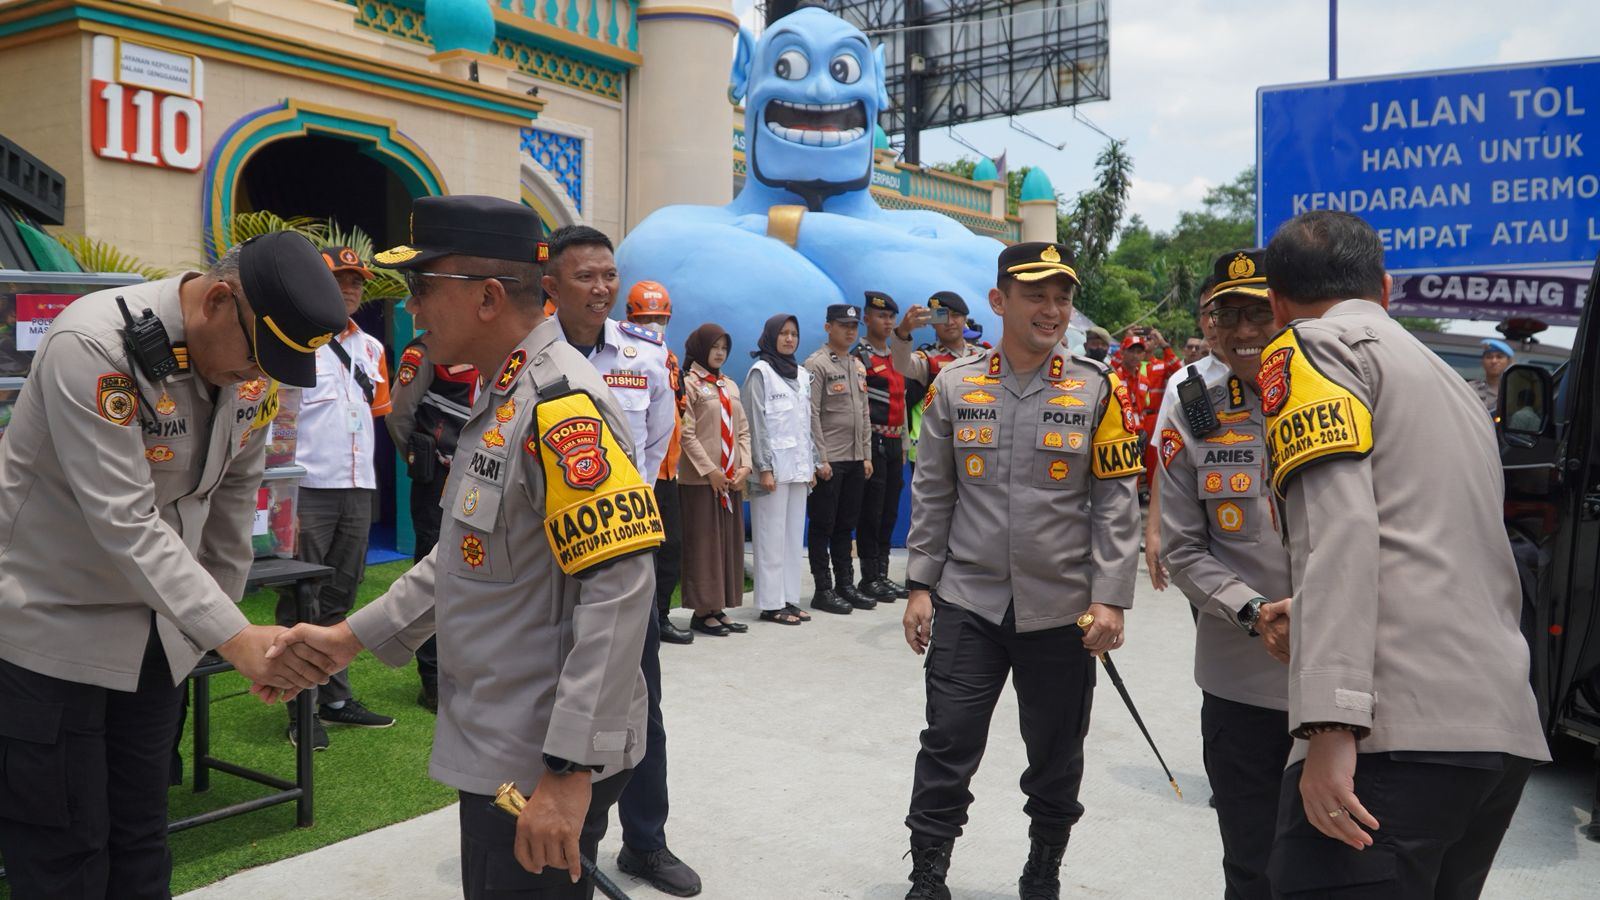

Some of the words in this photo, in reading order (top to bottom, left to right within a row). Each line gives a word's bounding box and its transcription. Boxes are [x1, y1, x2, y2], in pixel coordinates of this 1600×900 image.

[1362, 92, 1486, 132] JALAN
[1509, 86, 1585, 120] TOL
[101, 83, 202, 169] 110
[1362, 143, 1462, 172] HANYA
[1480, 133, 1584, 164] UNTUK
[1292, 182, 1471, 215] KENDARAAN
[1492, 174, 1600, 204] BERMO
[1378, 224, 1472, 251] EMPAT
[1491, 219, 1568, 246] ATAU
[1419, 275, 1564, 307] CABANG
[1258, 352, 1285, 379] POLDA
[606, 376, 646, 388] DISHUB
[956, 408, 998, 421] WIKHA
[1043, 412, 1086, 427] POLRI
[1280, 401, 1345, 444] OBYEK
[551, 422, 595, 443] POLDA
[561, 440, 577, 451] JAWA
[469, 452, 500, 481] POLRI
[1203, 449, 1255, 464] ARIES
[549, 488, 657, 551] KAOPSDA
[570, 530, 612, 558] KETUPAT
